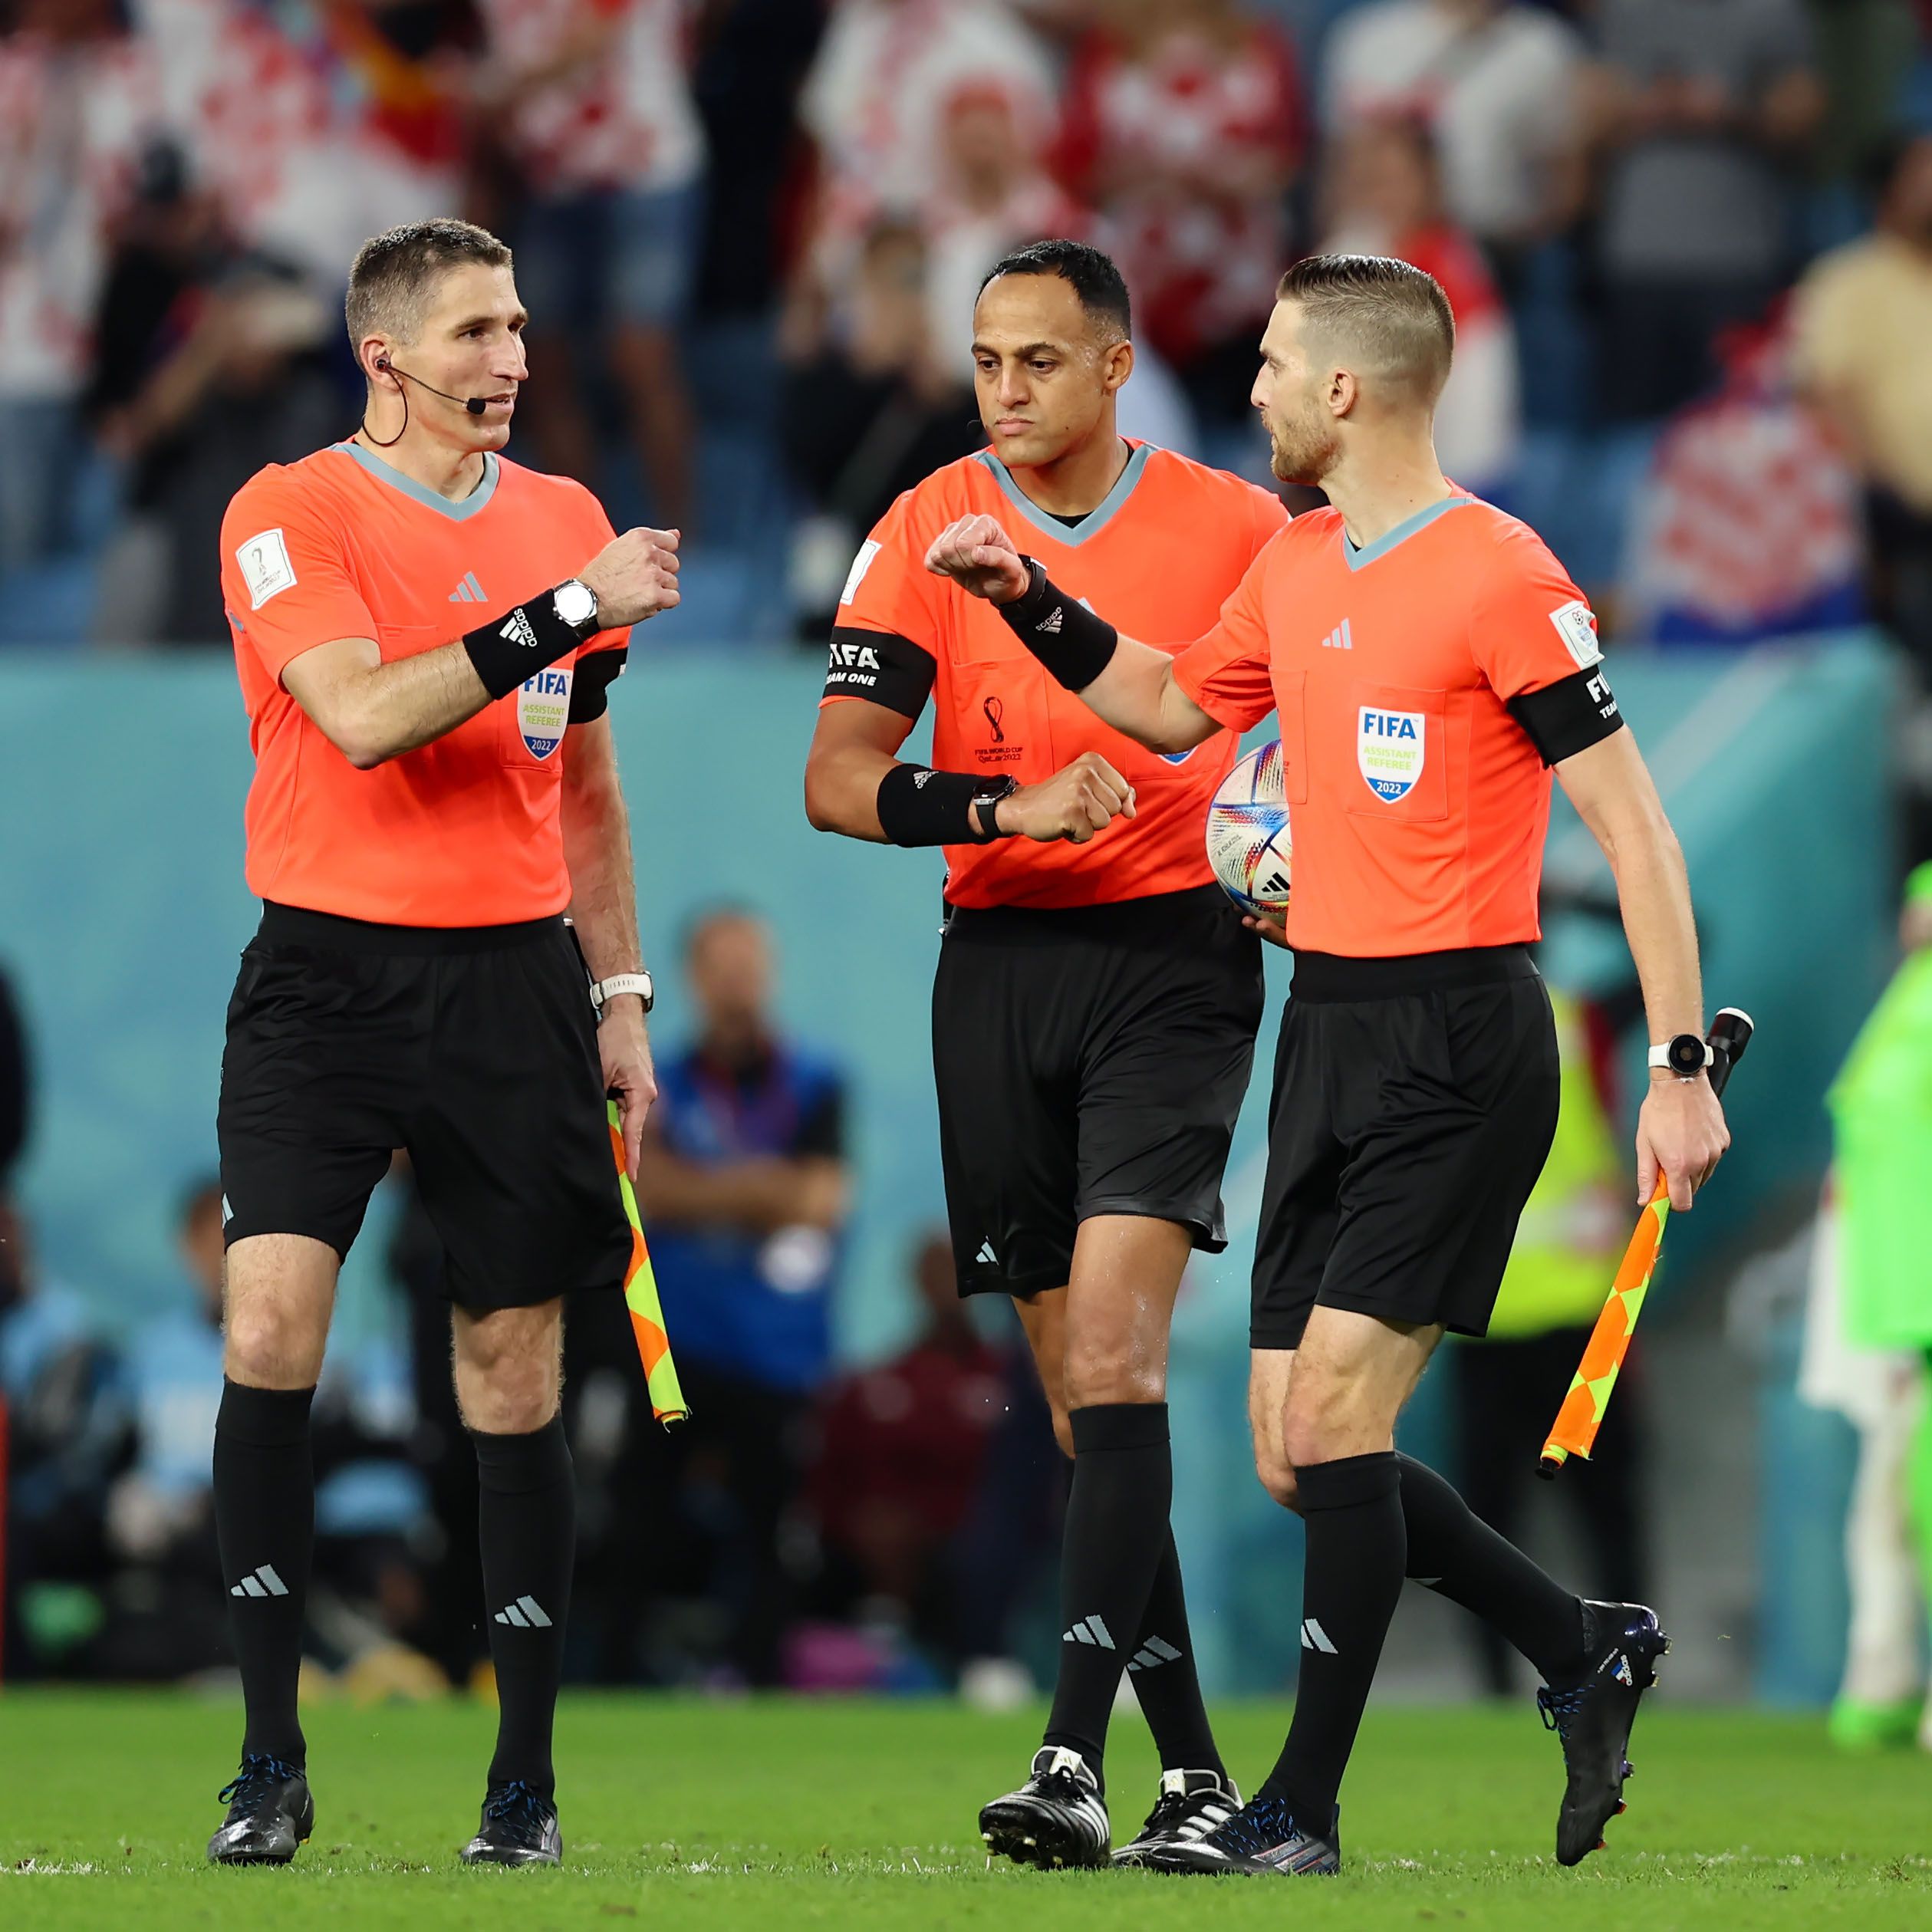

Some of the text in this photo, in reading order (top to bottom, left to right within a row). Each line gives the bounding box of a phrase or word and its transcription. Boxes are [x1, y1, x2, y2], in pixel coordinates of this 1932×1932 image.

[1035, 607, 1061, 631] adidas
[514, 608, 538, 647] adidas
[829, 643, 880, 670] IFA
[848, 673, 877, 686] ONE
[523, 705, 565, 716] ASSISTANT
[525, 716, 561, 727] REFEREE
[1364, 713, 1417, 740] FIFA
[532, 739, 551, 751] 2022
[1364, 746, 1417, 759] ASSISTANT
[1368, 757, 1412, 771] REFEREE
[1377, 781, 1402, 795] 2022
